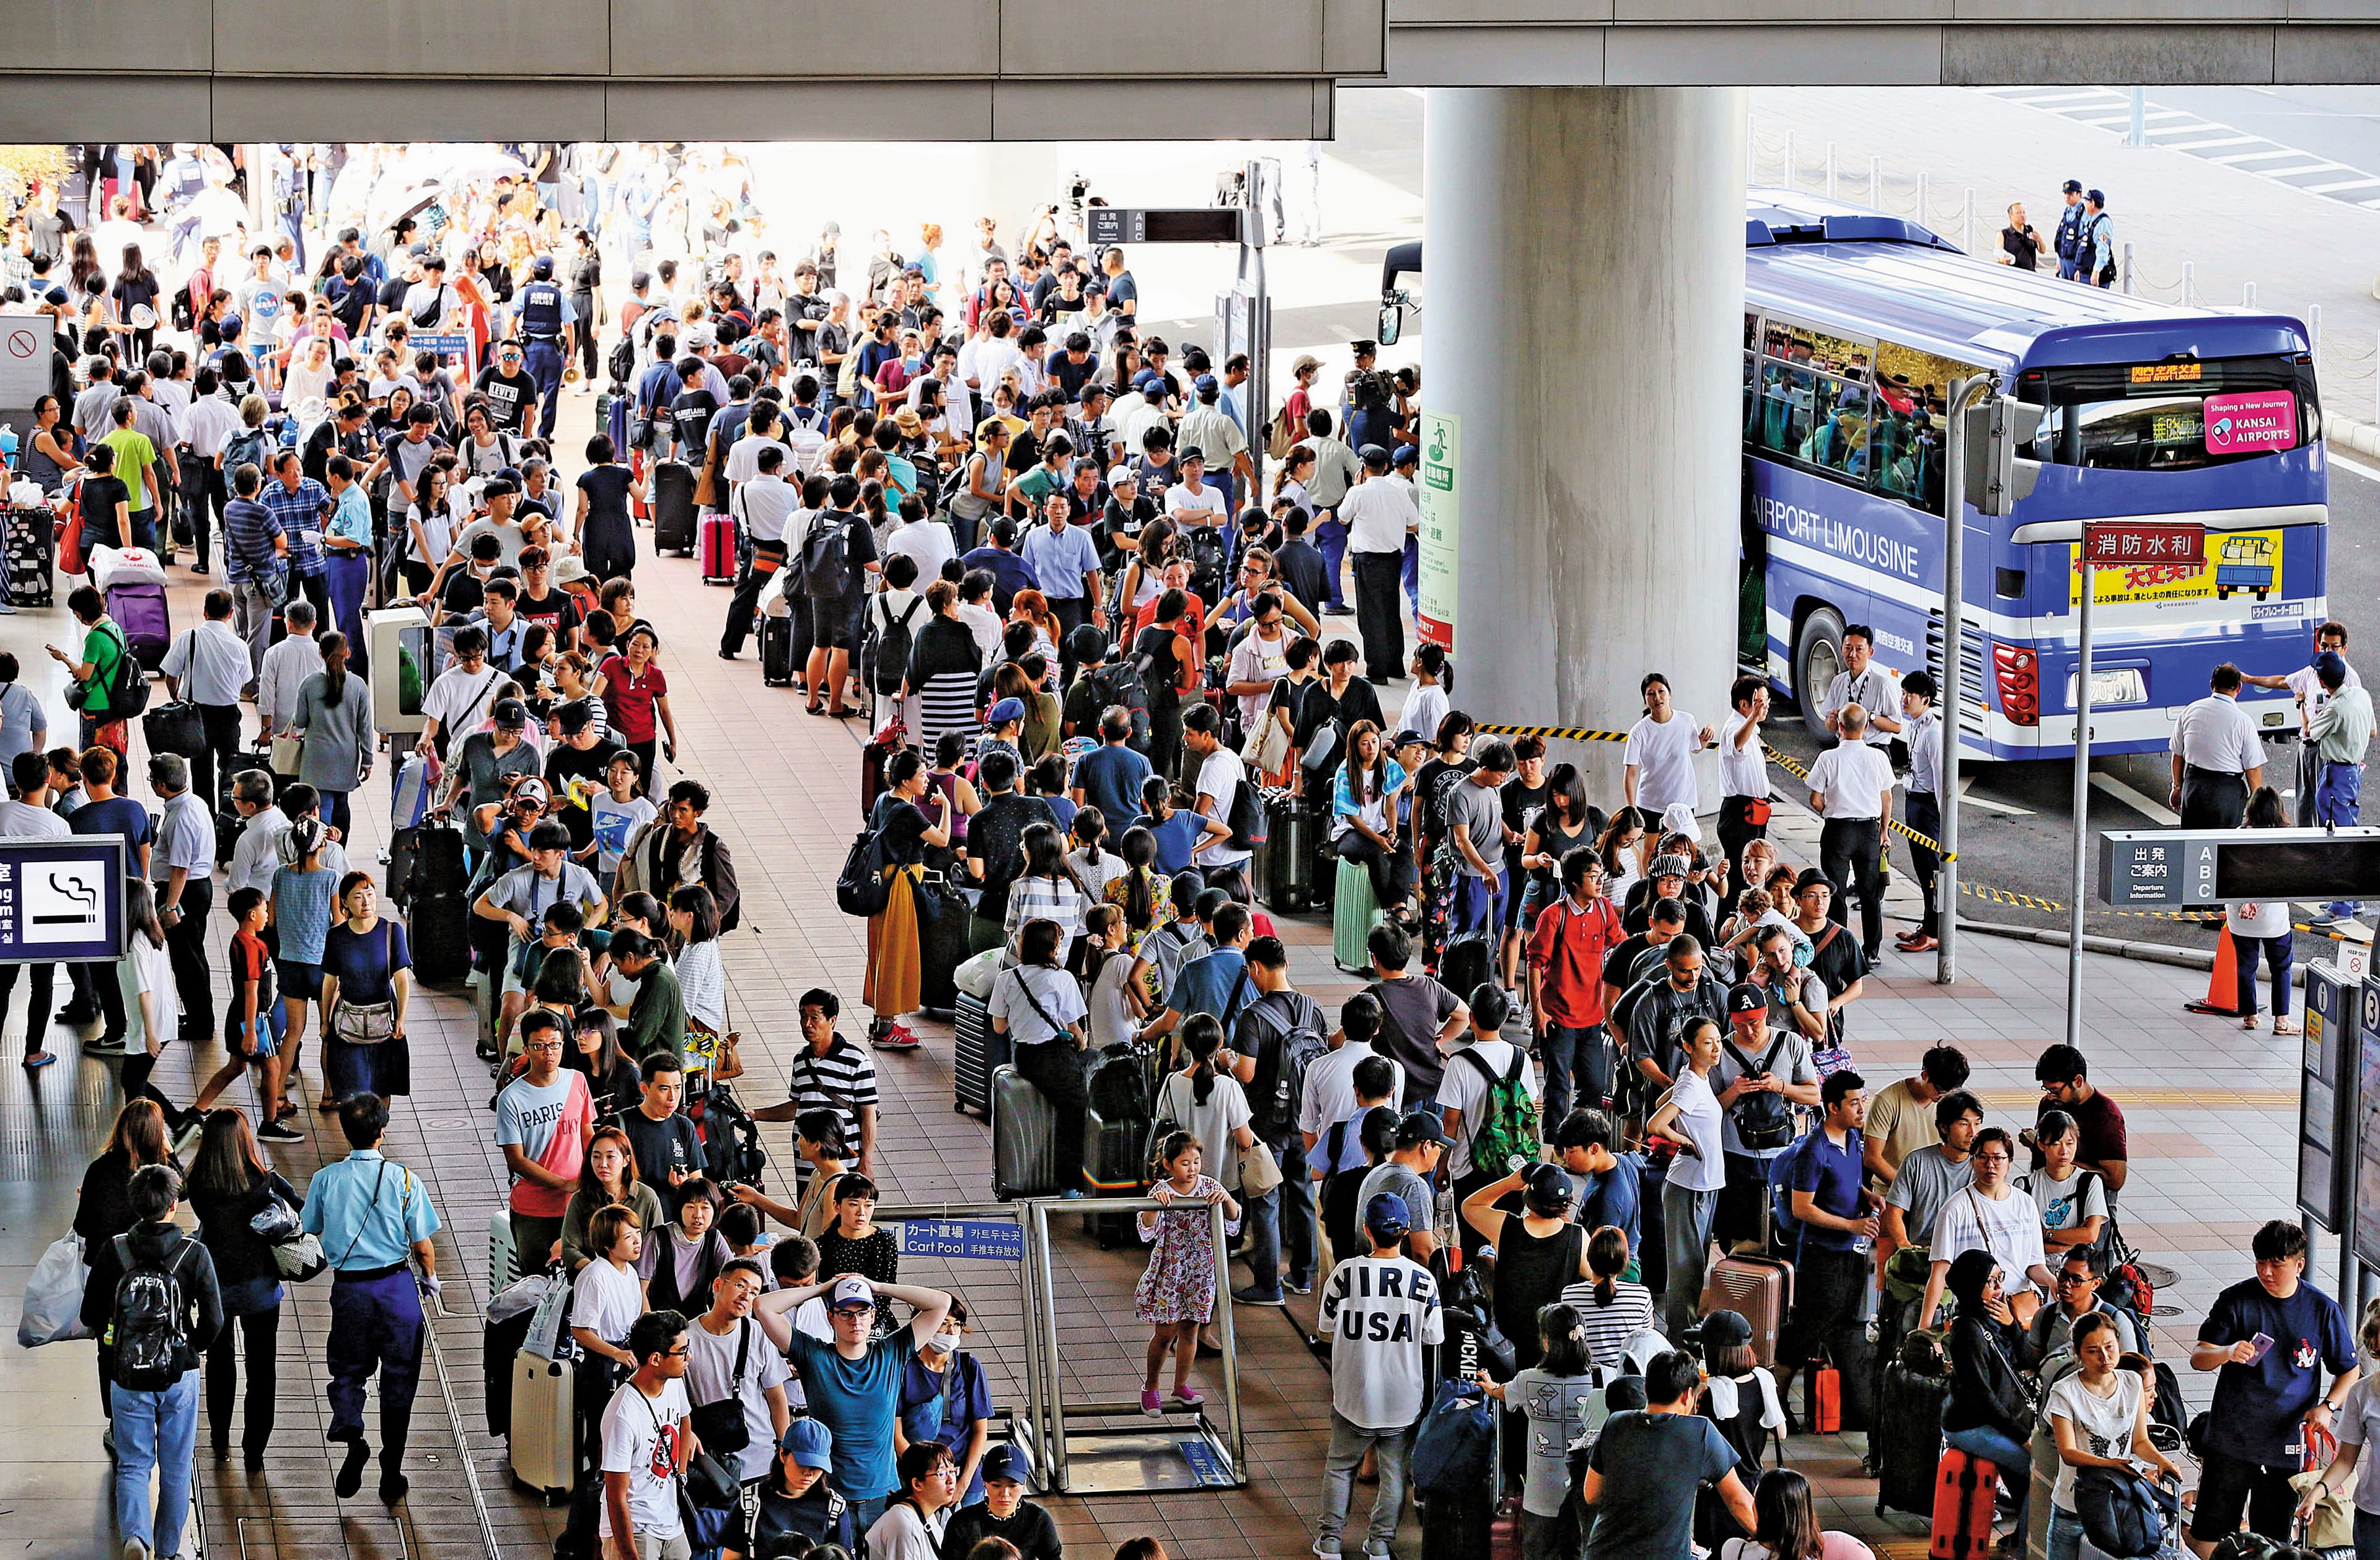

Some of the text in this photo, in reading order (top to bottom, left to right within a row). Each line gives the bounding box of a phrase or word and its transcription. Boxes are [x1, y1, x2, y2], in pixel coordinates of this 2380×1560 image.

[1135, 212, 1142, 221] A
[1135, 223, 1142, 231] B
[1135, 232, 1142, 240] C
[2153, 373, 2173, 382] Airport
[2175, 372, 2201, 381] Limousine
[490, 384, 516, 399] LEVI'S
[2211, 403, 2238, 413] Shaping
[2246, 402, 2261, 410] New
[2262, 400, 2288, 410] Journey
[2236, 416, 2277, 430] KANSAI
[2236, 429, 2290, 443] AIRPORTS
[1751, 493, 1919, 579] AIRPORT LIMOUSINE
[2096, 533, 2192, 556] 消防水利
[1875, 627, 1914, 656] 関西空港交通
[508, 707, 518, 719] T
[2134, 847, 2166, 862] 出発
[2199, 846, 2213, 861] A
[2130, 863, 2168, 878] ご案内
[2199, 865, 2211, 879] B
[2133, 884, 2164, 892] Departure
[2198, 883, 2211, 898] C
[1740, 994, 1755, 1010] A
[2368, 995, 2376, 1025] 3
[521, 1102, 563, 1128] PARIS
[908, 1223, 964, 1238] カート置場
[971, 1228, 1021, 1241] 카트두는곳
[907, 1240, 964, 1254] Cart Pool
[970, 1244, 1021, 1258] 手推车存放处
[1342, 1309, 1413, 1343] USA
